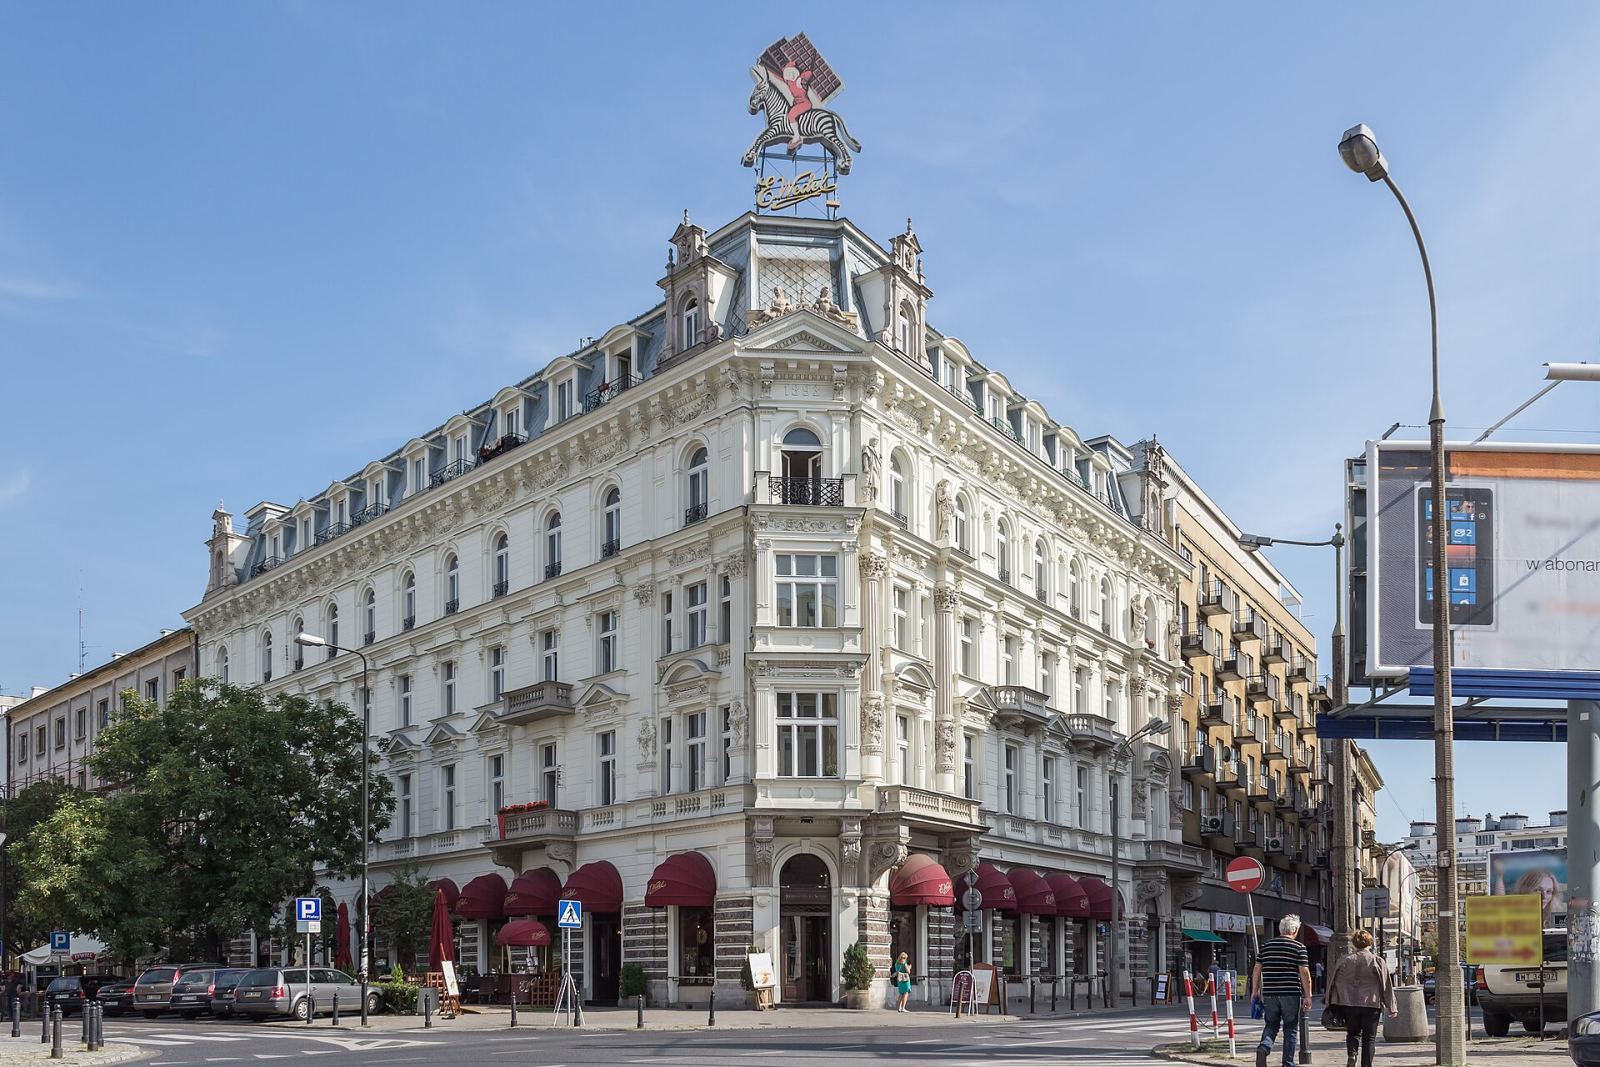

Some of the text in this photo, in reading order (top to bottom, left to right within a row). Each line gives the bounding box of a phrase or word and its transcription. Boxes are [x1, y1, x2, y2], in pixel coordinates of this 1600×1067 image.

[1466, 529, 1472, 537] 2
[1526, 559, 1540, 570] w
[301, 900, 315, 918] P
[56, 934, 66, 947] P
